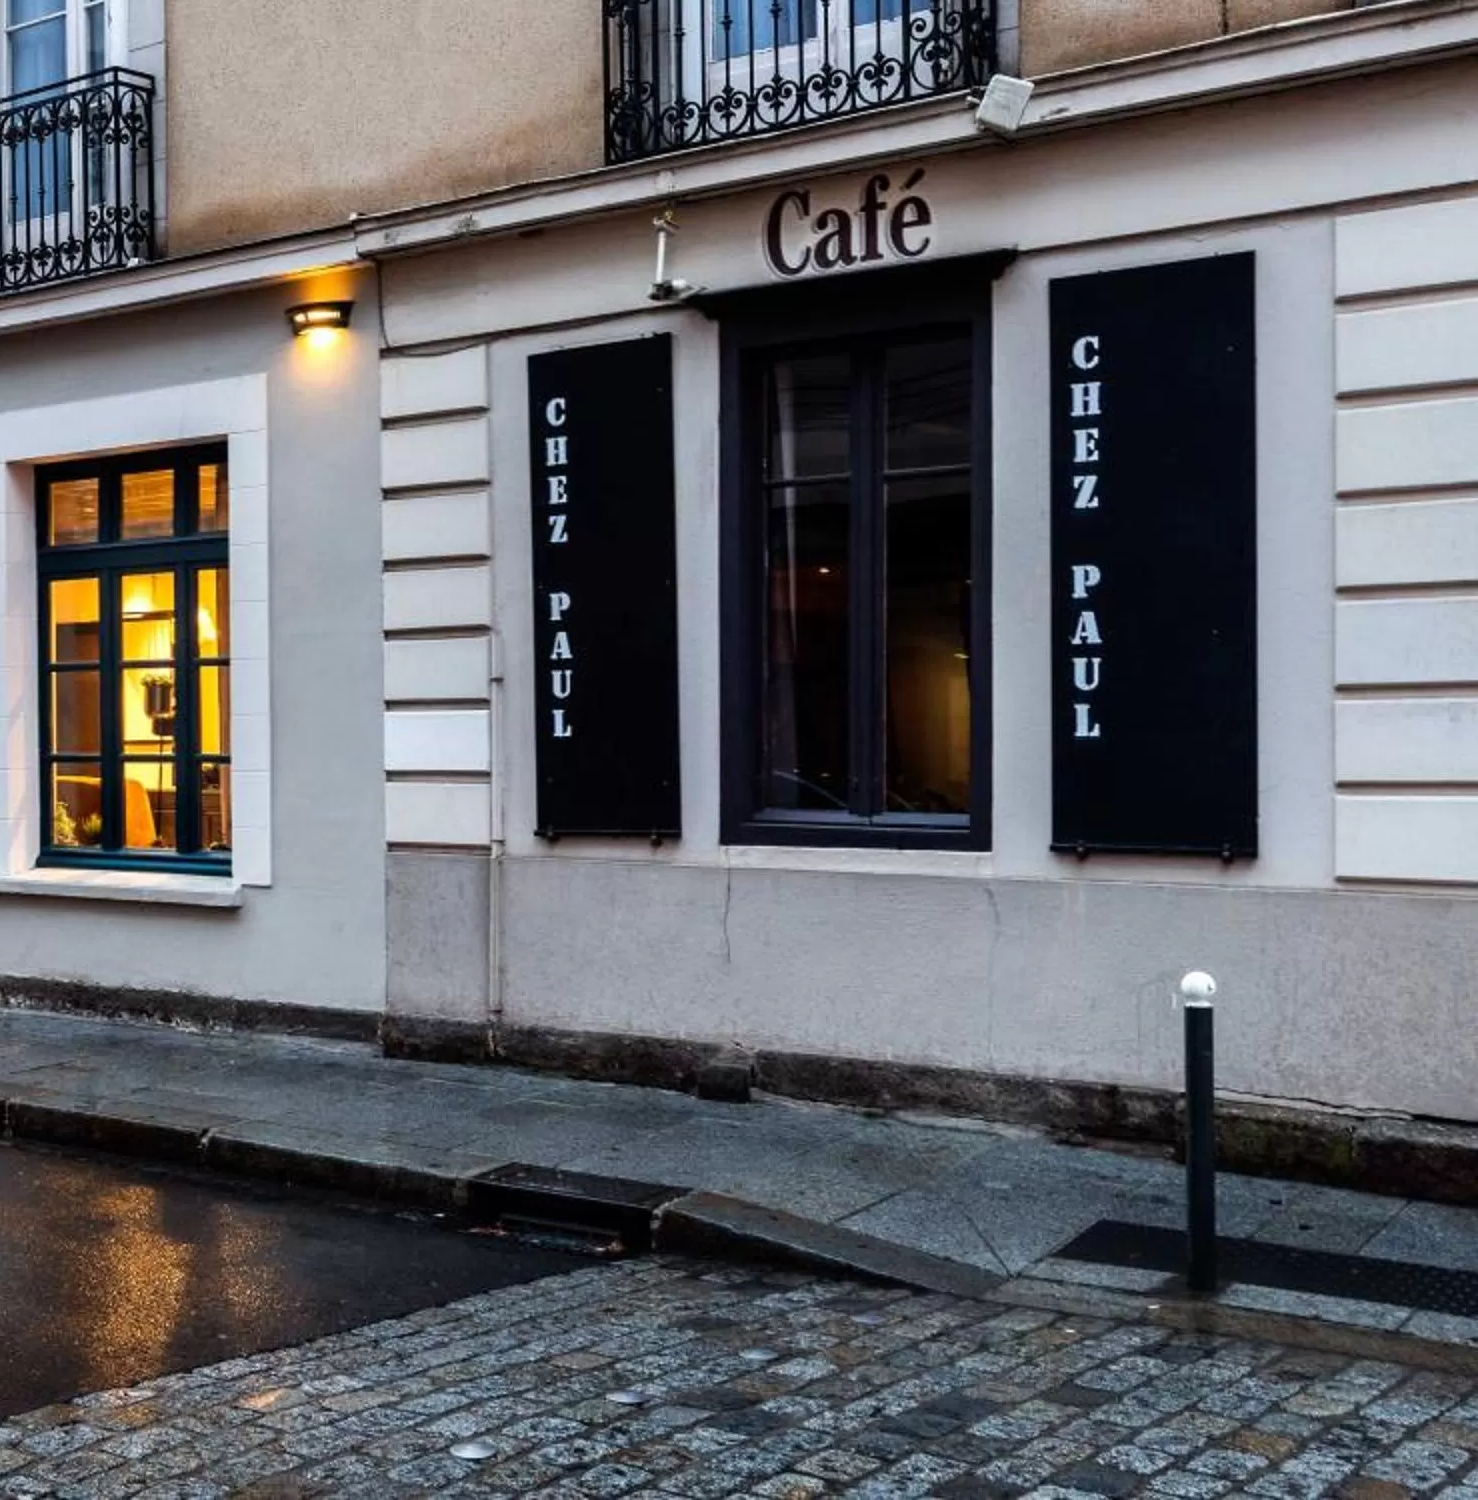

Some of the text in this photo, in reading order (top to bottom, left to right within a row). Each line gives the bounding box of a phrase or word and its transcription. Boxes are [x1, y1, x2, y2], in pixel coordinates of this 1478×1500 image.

[765, 167, 932, 276] Café
[545, 398, 572, 737] CHEZ PAUL
[1069, 335, 1103, 738] CHEZ PAUL
